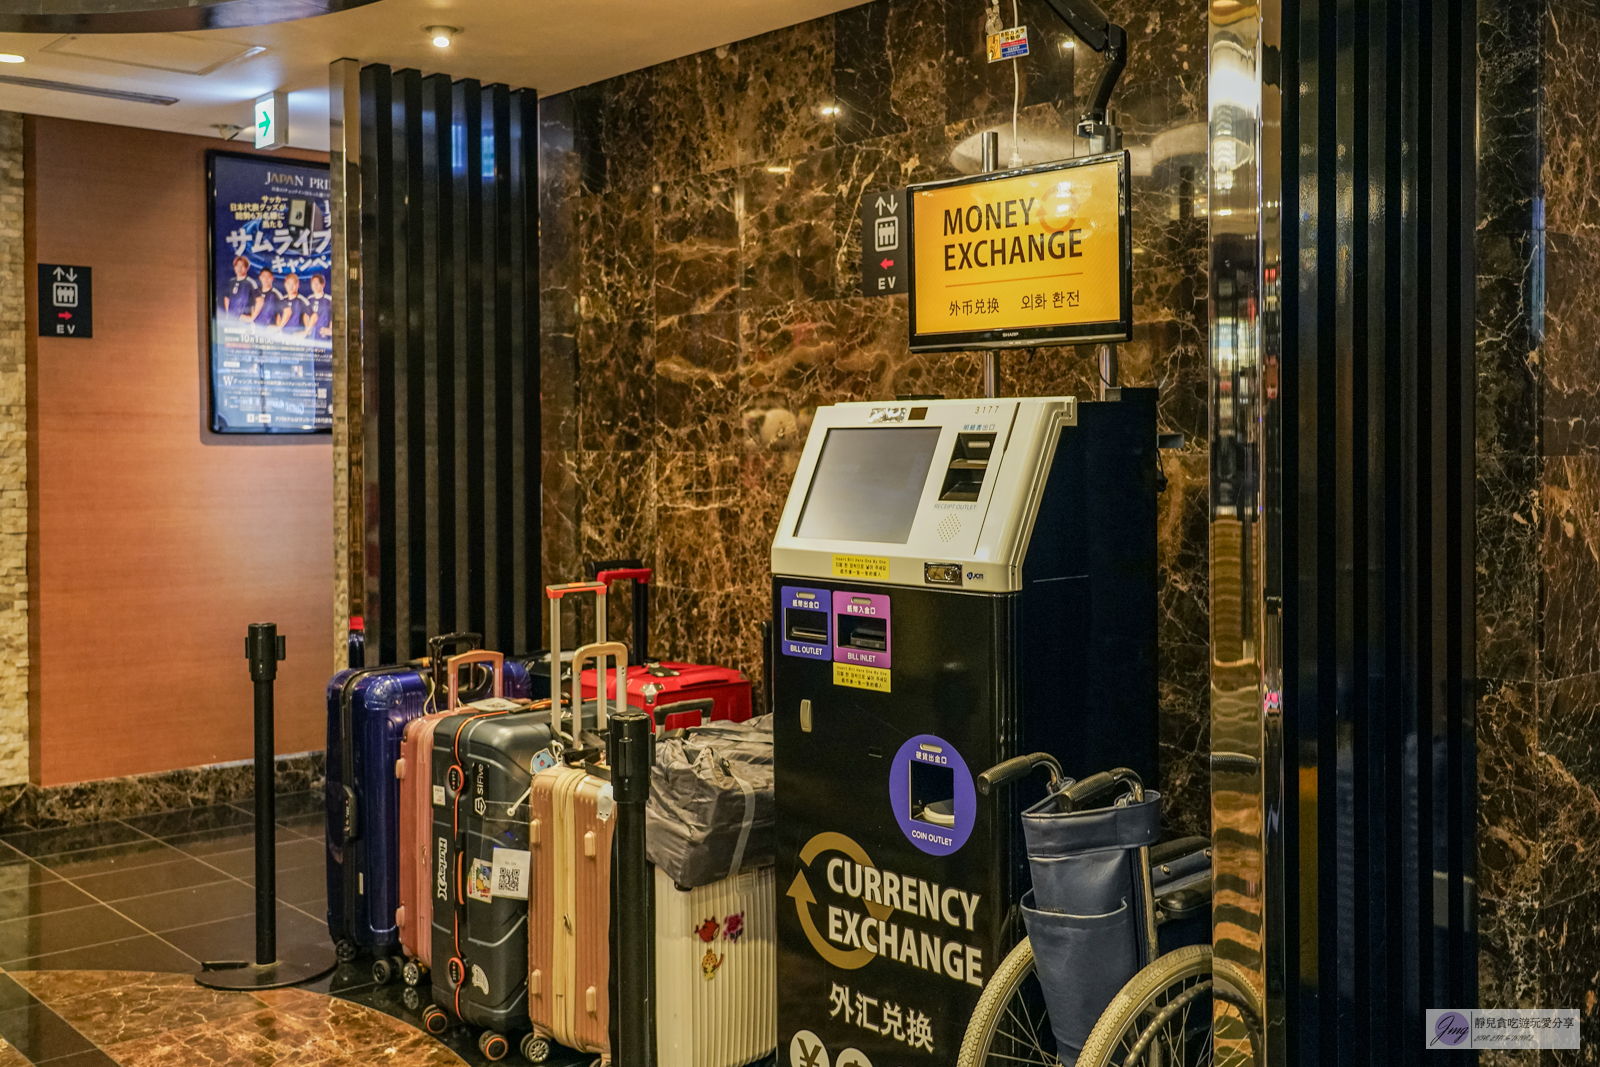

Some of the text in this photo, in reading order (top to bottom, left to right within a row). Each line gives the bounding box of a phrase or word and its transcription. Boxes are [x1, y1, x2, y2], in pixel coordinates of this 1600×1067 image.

[264, 171, 304, 187] JAPAN
[943, 197, 1035, 237] MONEY
[944, 228, 1083, 272] EXCHANGE
[272, 255, 331, 273] キャンペ
[878, 276, 896, 290] EV
[949, 297, 999, 317] 外币兑换
[1020, 290, 1080, 311] 외화 환전
[56, 323, 76, 335] EV
[974, 405, 999, 415] 3177
[790, 644, 822, 656] BILL OUTLET
[847, 652, 876, 663] BILL INLET
[912, 830, 953, 846] COIN OUTLET
[438, 837, 447, 884] Hurley
[827, 856, 982, 932] CURRENCY
[828, 904, 984, 988] EXCHANGE
[828, 981, 935, 1054] 外汇兑换
